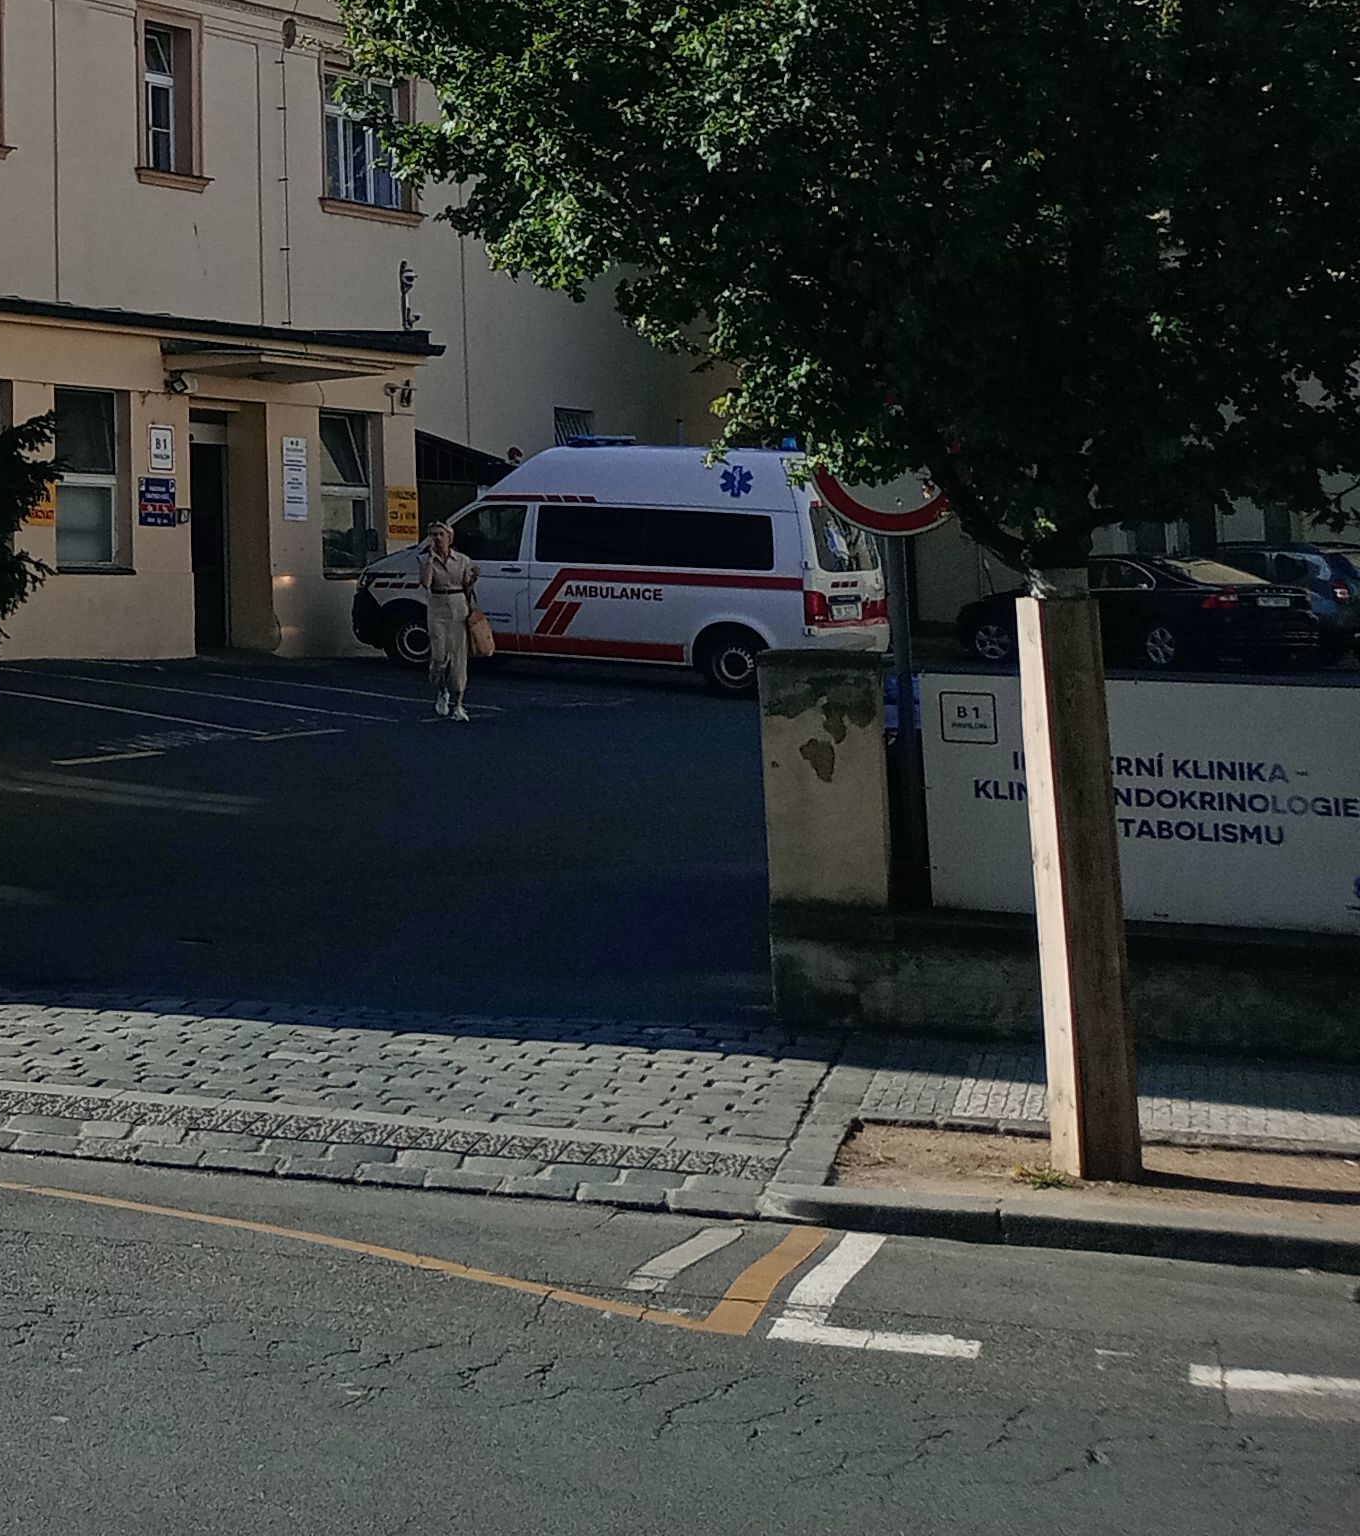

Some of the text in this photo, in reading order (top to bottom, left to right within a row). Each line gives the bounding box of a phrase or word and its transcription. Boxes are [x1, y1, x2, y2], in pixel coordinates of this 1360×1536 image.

[155, 438, 161, 450] B
[564, 584, 664, 602] AMBULANCE
[957, 706, 980, 719] B 1
[1172, 758, 1290, 784] KLINIKA
[1113, 786, 1360, 818] NDOKRINOLOGIE
[1117, 817, 1285, 846] TABOLISMU
